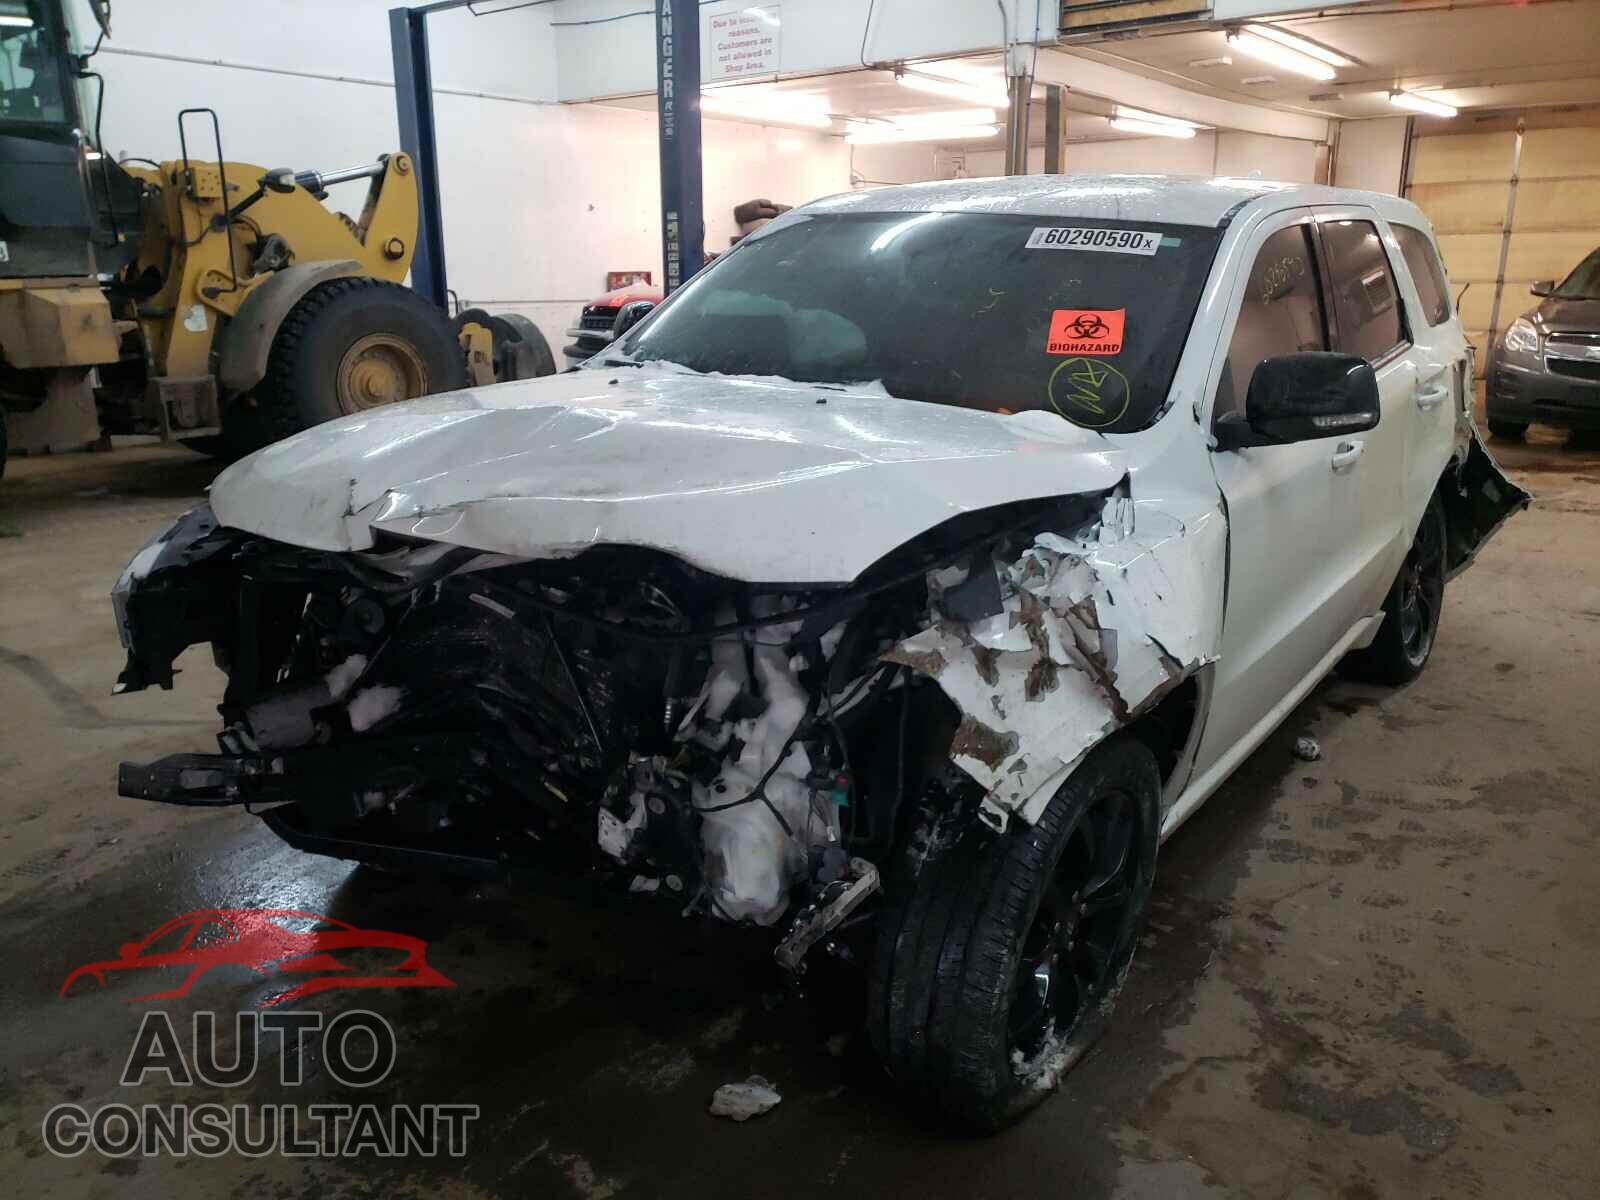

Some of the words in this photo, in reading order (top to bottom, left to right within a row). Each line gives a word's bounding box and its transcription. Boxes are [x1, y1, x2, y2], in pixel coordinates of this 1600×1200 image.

[718, 39, 758, 50] Customers
[733, 50, 763, 60] allowed
[1050, 343, 1120, 352] BIOHAZARD
